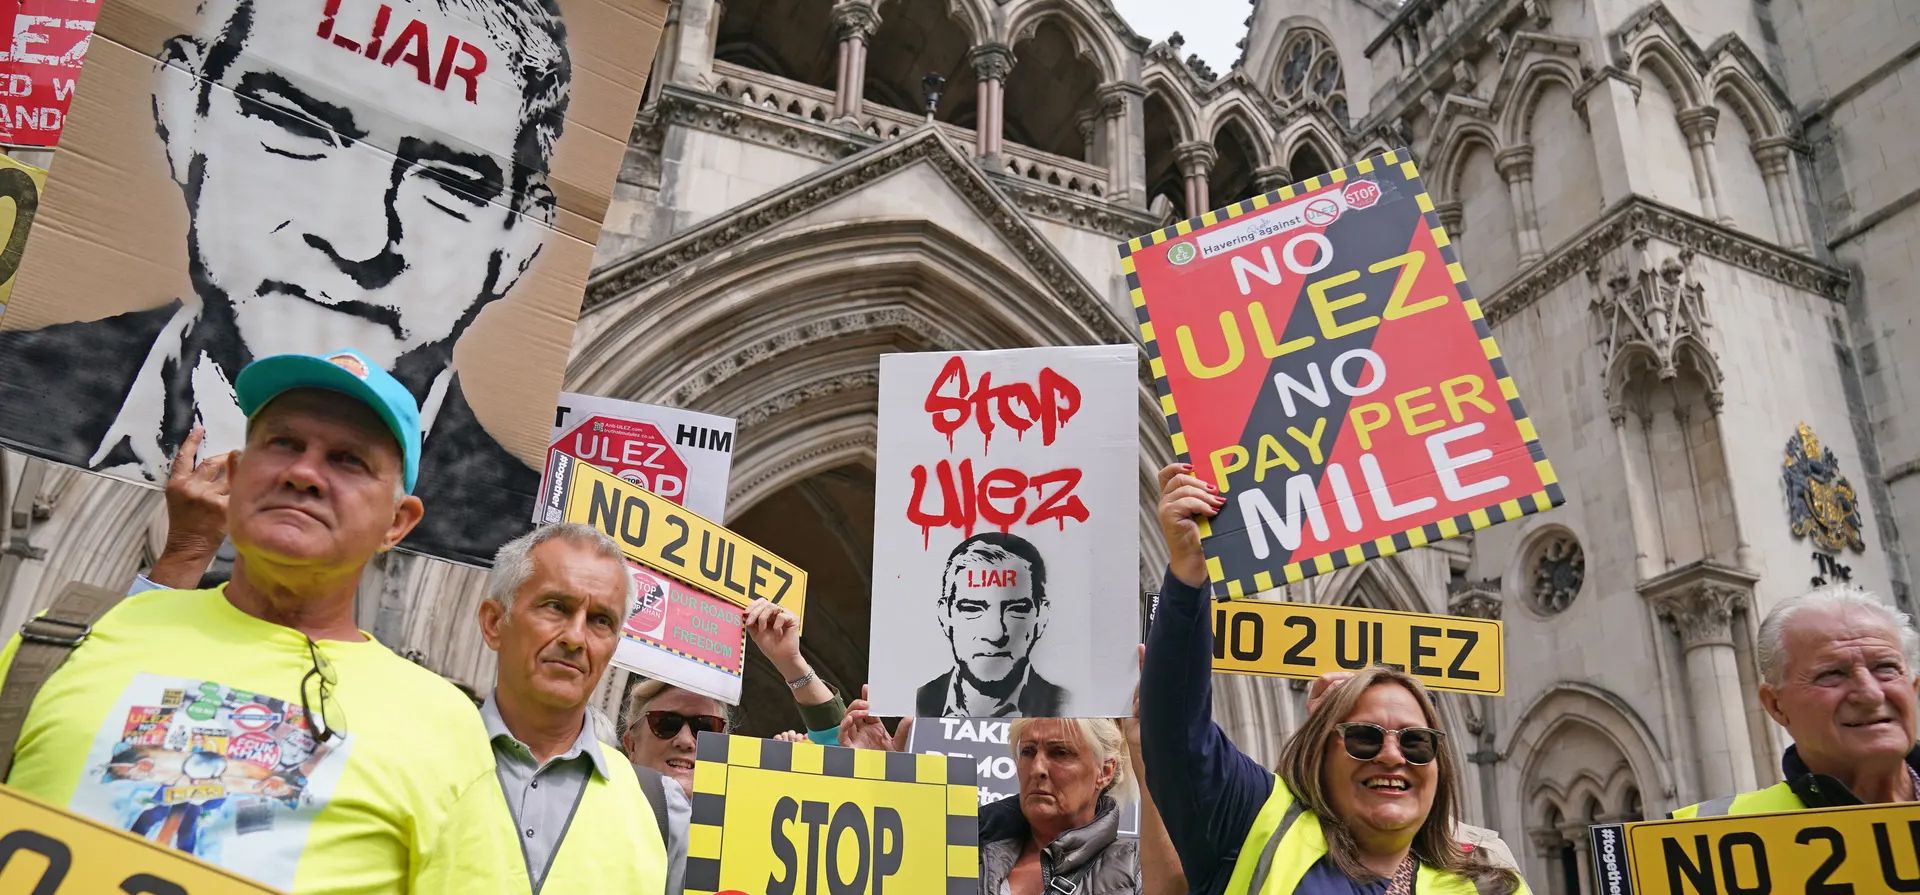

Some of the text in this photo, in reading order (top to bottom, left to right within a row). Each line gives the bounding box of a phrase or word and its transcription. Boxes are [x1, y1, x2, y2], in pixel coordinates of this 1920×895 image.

[316, 0, 488, 105] LIAR
[1345, 185, 1377, 205] STOP
[1203, 232, 1256, 256] Havering
[1258, 215, 1301, 237] against
[1230, 232, 1335, 295] NO
[1175, 250, 1449, 380] ULEZ
[924, 355, 1082, 450] Stop
[1273, 348, 1387, 418] NO
[575, 432, 668, 470] ULEZ
[675, 423, 733, 453] HIM
[1209, 373, 1496, 493] PAY PER
[551, 454, 569, 508] #together
[1237, 421, 1510, 560] MILE
[587, 478, 794, 605] NO 2 ULEZ
[1811, 551, 1852, 580] The
[670, 588, 742, 627] OUR ROADS
[967, 569, 1017, 588] LIAR
[672, 625, 734, 658] FREEDOM
[691, 615, 719, 635] OUR
[1282, 615, 1317, 667] 2
[1335, 618, 1480, 682] ULEZ
[765, 795, 904, 895] STOP
[1661, 831, 1773, 895] NO
[1795, 825, 1855, 895] 2
